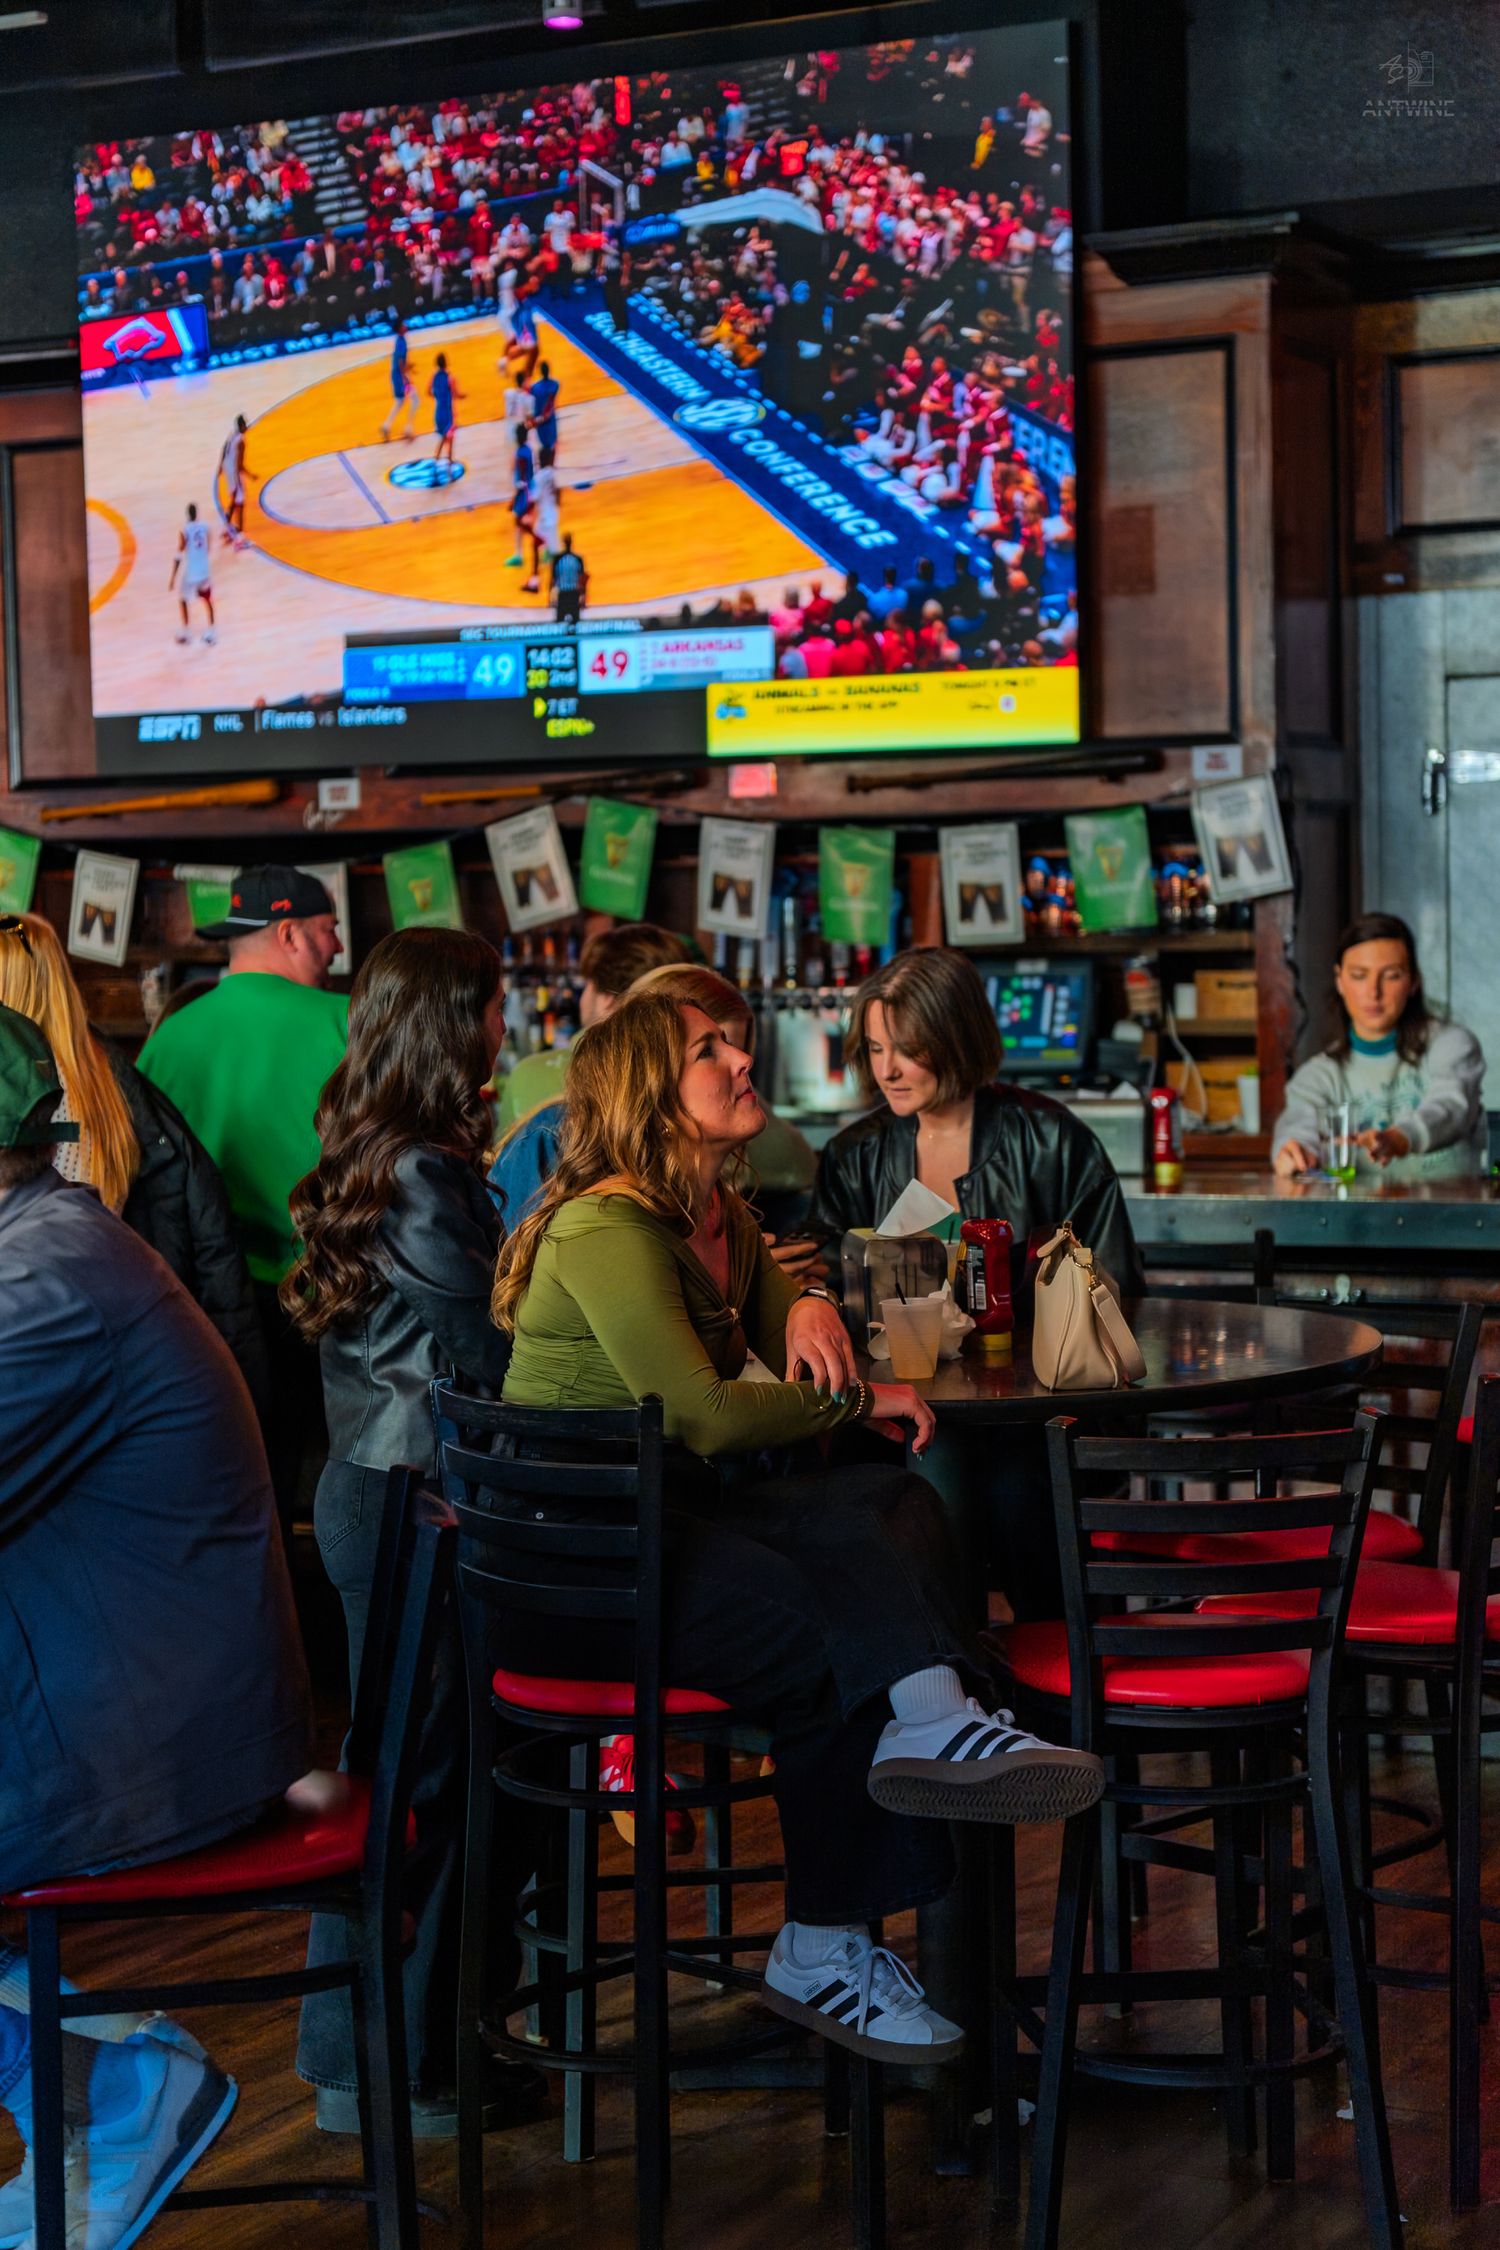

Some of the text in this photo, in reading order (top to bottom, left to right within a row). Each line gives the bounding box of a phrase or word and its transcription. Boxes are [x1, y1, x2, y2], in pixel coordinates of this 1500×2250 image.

[728, 429, 898, 549] CONFERENCE
[472, 653, 515, 686] 49
[590, 650, 630, 680] 49
[138, 714, 202, 742] ESPN
[261, 708, 317, 730] Flames
[337, 704, 408, 728] Islanders
